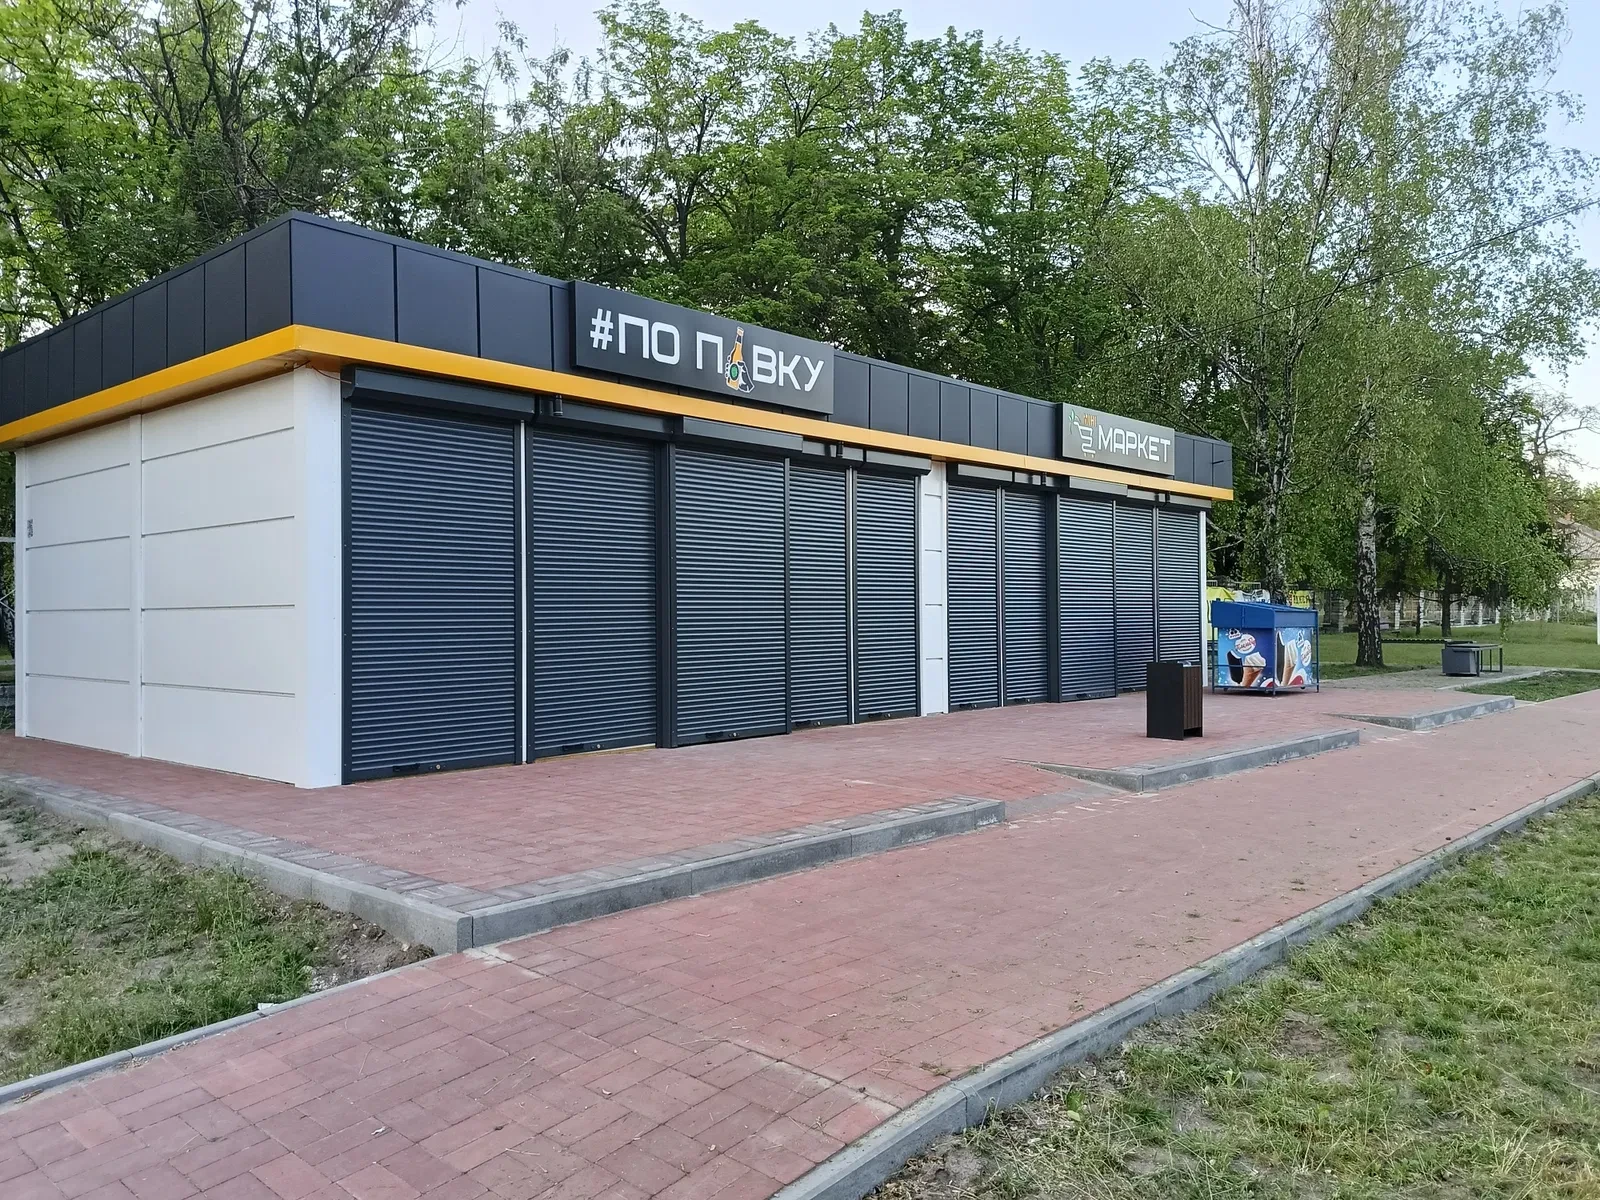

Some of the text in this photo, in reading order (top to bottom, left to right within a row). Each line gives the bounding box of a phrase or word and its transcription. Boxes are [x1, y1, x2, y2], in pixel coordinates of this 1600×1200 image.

[590, 308, 824, 392] #ПО ПВКУ
[1098, 424, 1171, 463] МАРКЕТ
